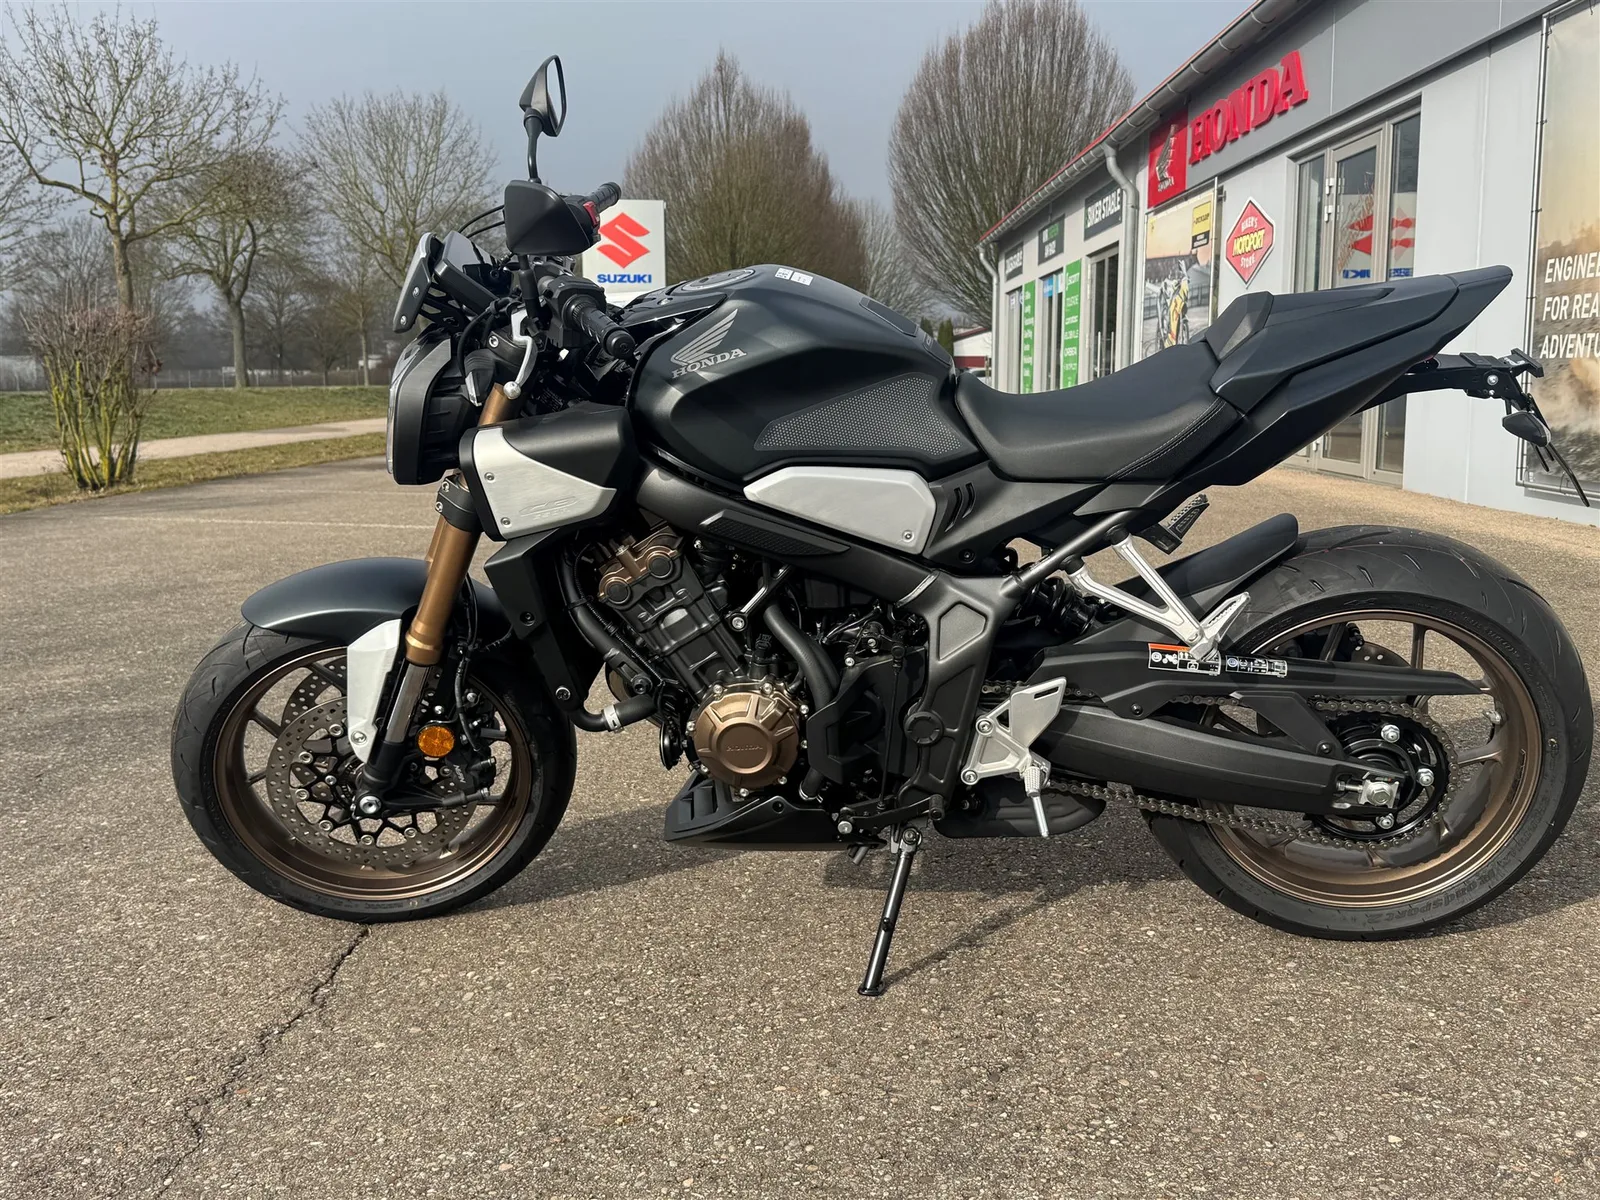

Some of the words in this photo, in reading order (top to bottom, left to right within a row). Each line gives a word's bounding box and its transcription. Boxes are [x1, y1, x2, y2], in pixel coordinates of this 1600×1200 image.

[1189, 49, 1308, 166] HONDA
[1102, 187, 1121, 219] STABLE
[1241, 216, 1258, 232] BIKER'S
[1231, 228, 1265, 257] MOTOPORT
[1240, 253, 1256, 268] STORE
[597, 274, 652, 283] SUZUKI
[1542, 295, 1570, 321] FOR
[1571, 292, 1599, 319] REA
[672, 348, 747, 379] HONDA
